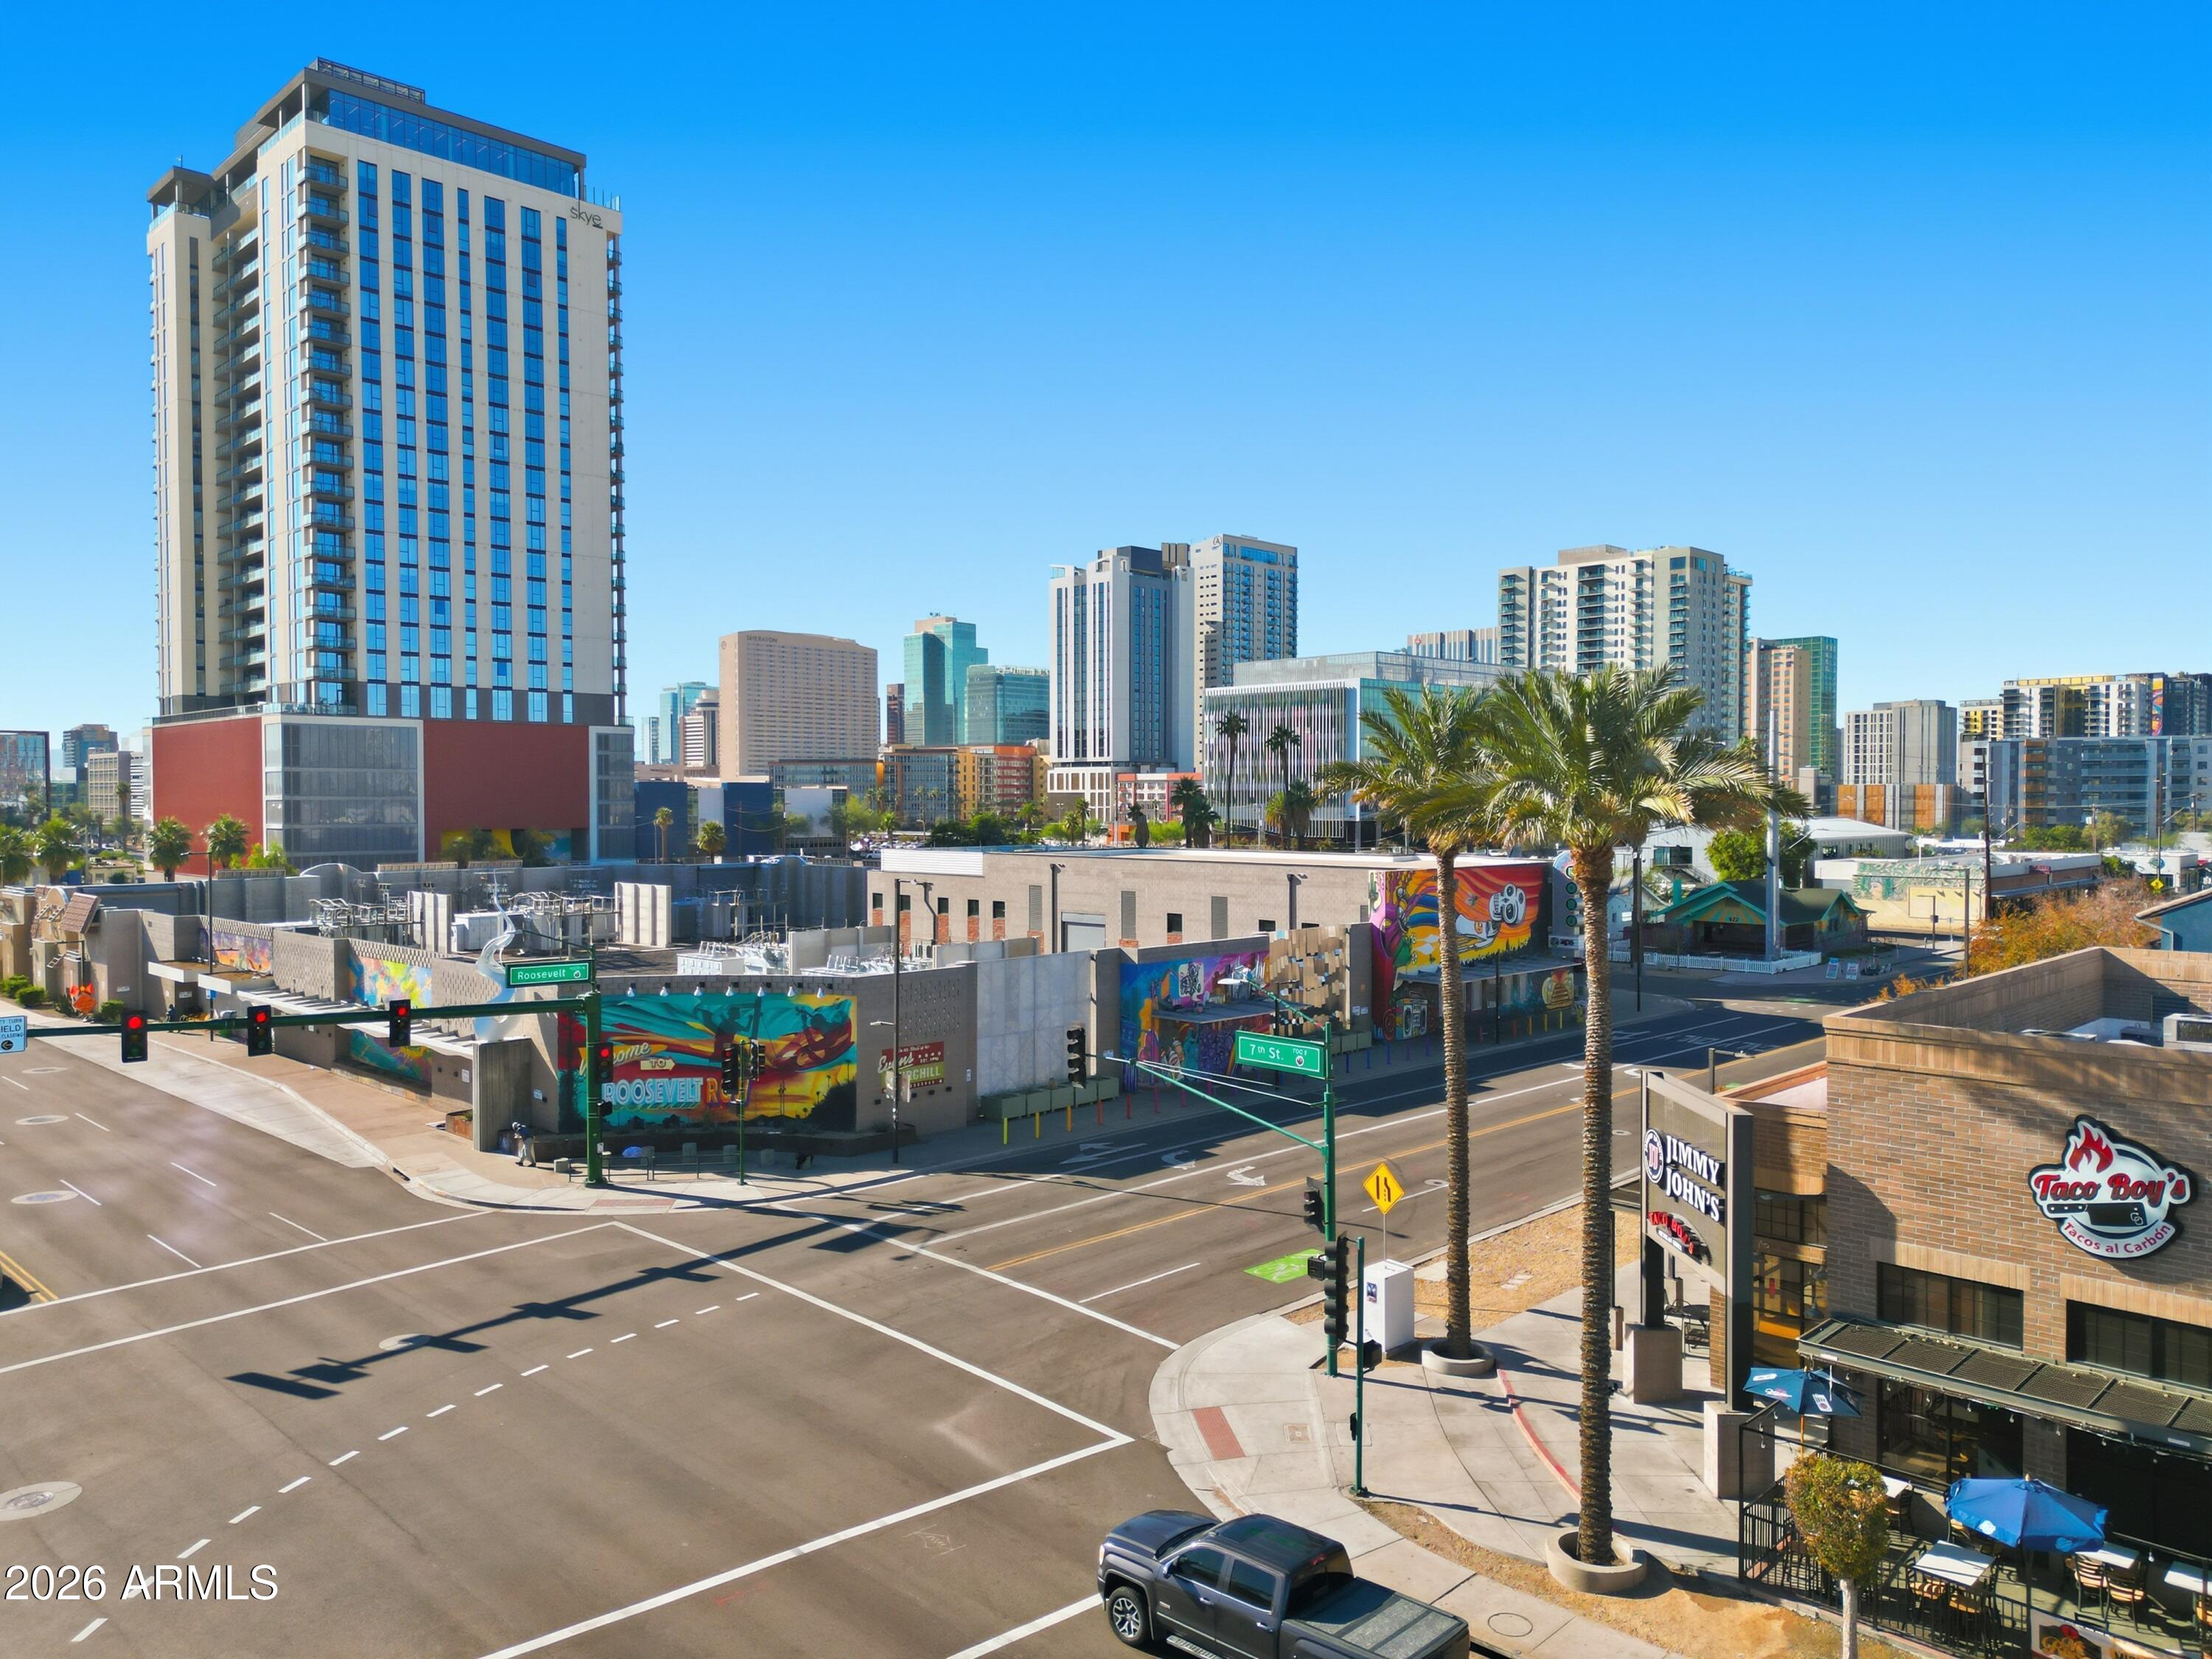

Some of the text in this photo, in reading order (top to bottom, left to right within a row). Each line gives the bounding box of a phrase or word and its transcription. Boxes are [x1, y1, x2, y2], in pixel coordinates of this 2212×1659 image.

[570, 206, 602, 227] skye
[518, 969, 566, 979] Roosevelt
[1, 1024, 21, 1032] IELD
[1250, 1044, 1284, 1060] 7th St.
[650, 1060, 667, 1069] TO
[602, 1077, 704, 1105] ROOSEVELT
[1666, 1135, 1719, 1186] JIMMY
[1666, 1167, 1719, 1222] JOHN'S
[2034, 1172, 2185, 1208] Taco Boy's
[1649, 1211, 1669, 1227] TACO
[2063, 1222, 2171, 1254] Tacos al Carbón
